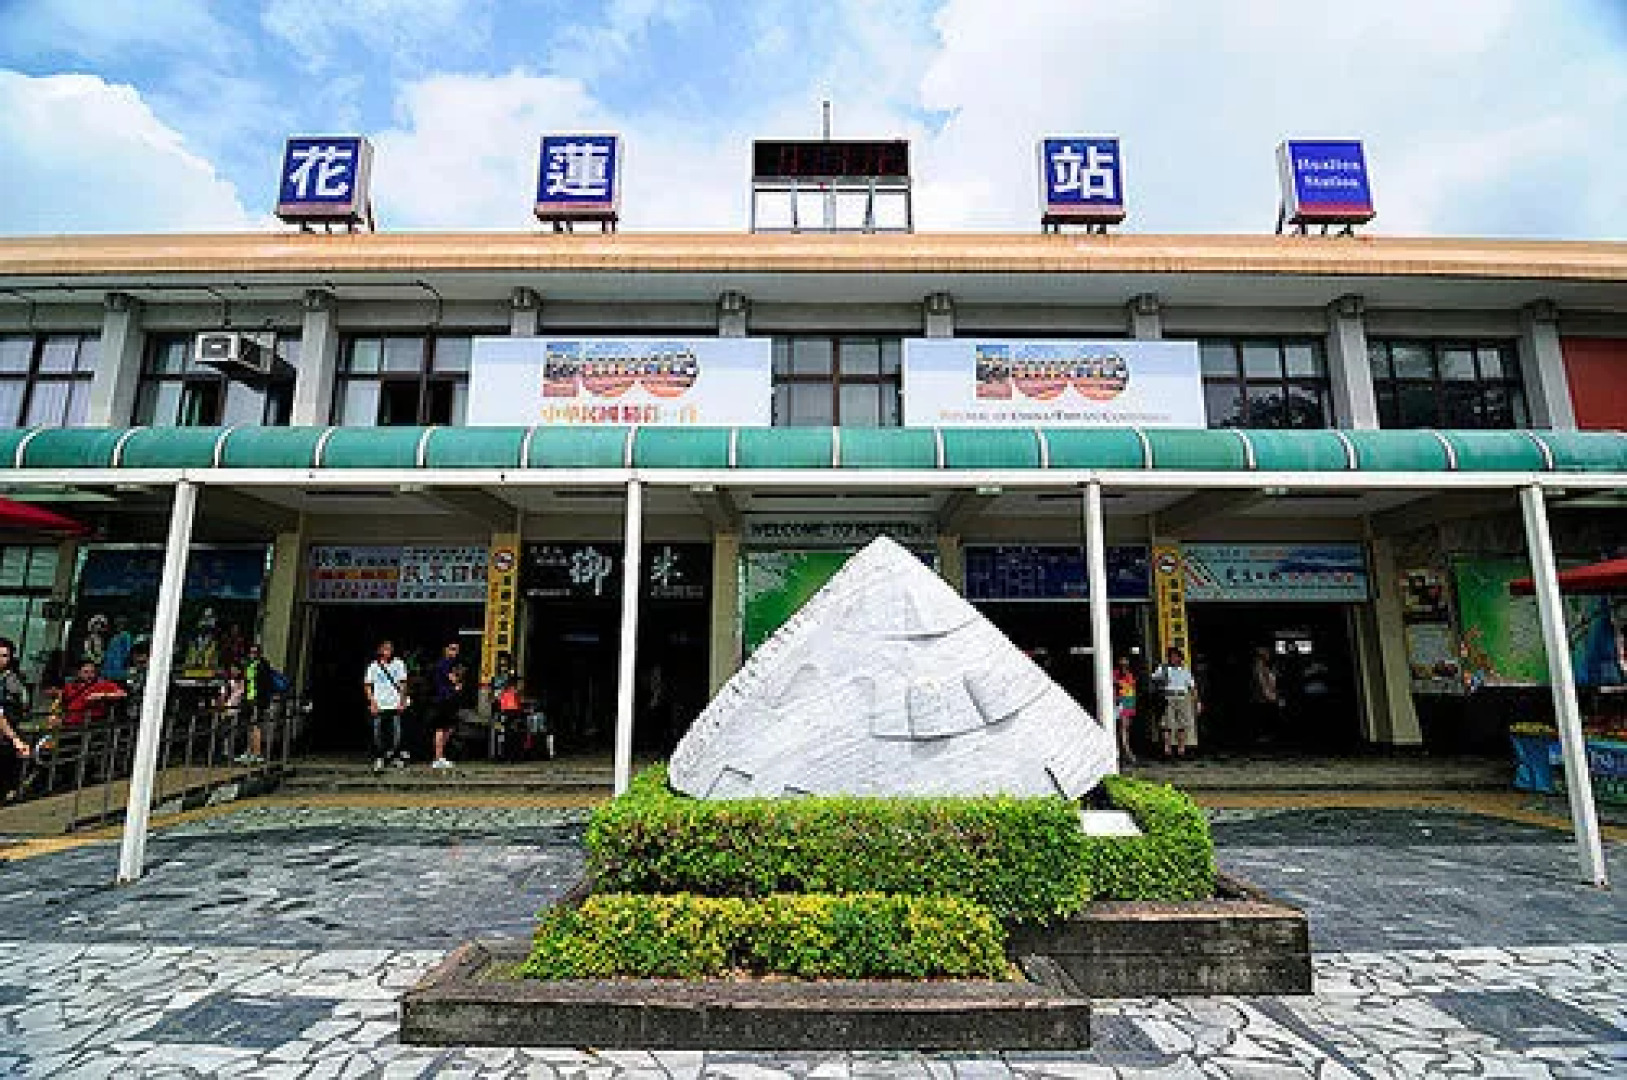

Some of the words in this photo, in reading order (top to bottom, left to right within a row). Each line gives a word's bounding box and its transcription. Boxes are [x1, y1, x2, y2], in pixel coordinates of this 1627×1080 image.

[290, 145, 352, 197] 花
[546, 142, 609, 196] 蓮
[1050, 145, 1114, 199] 站
[1297, 158, 1361, 172] Hualien
[1303, 175, 1360, 188] Station
[751, 523, 827, 538] WELCOME
